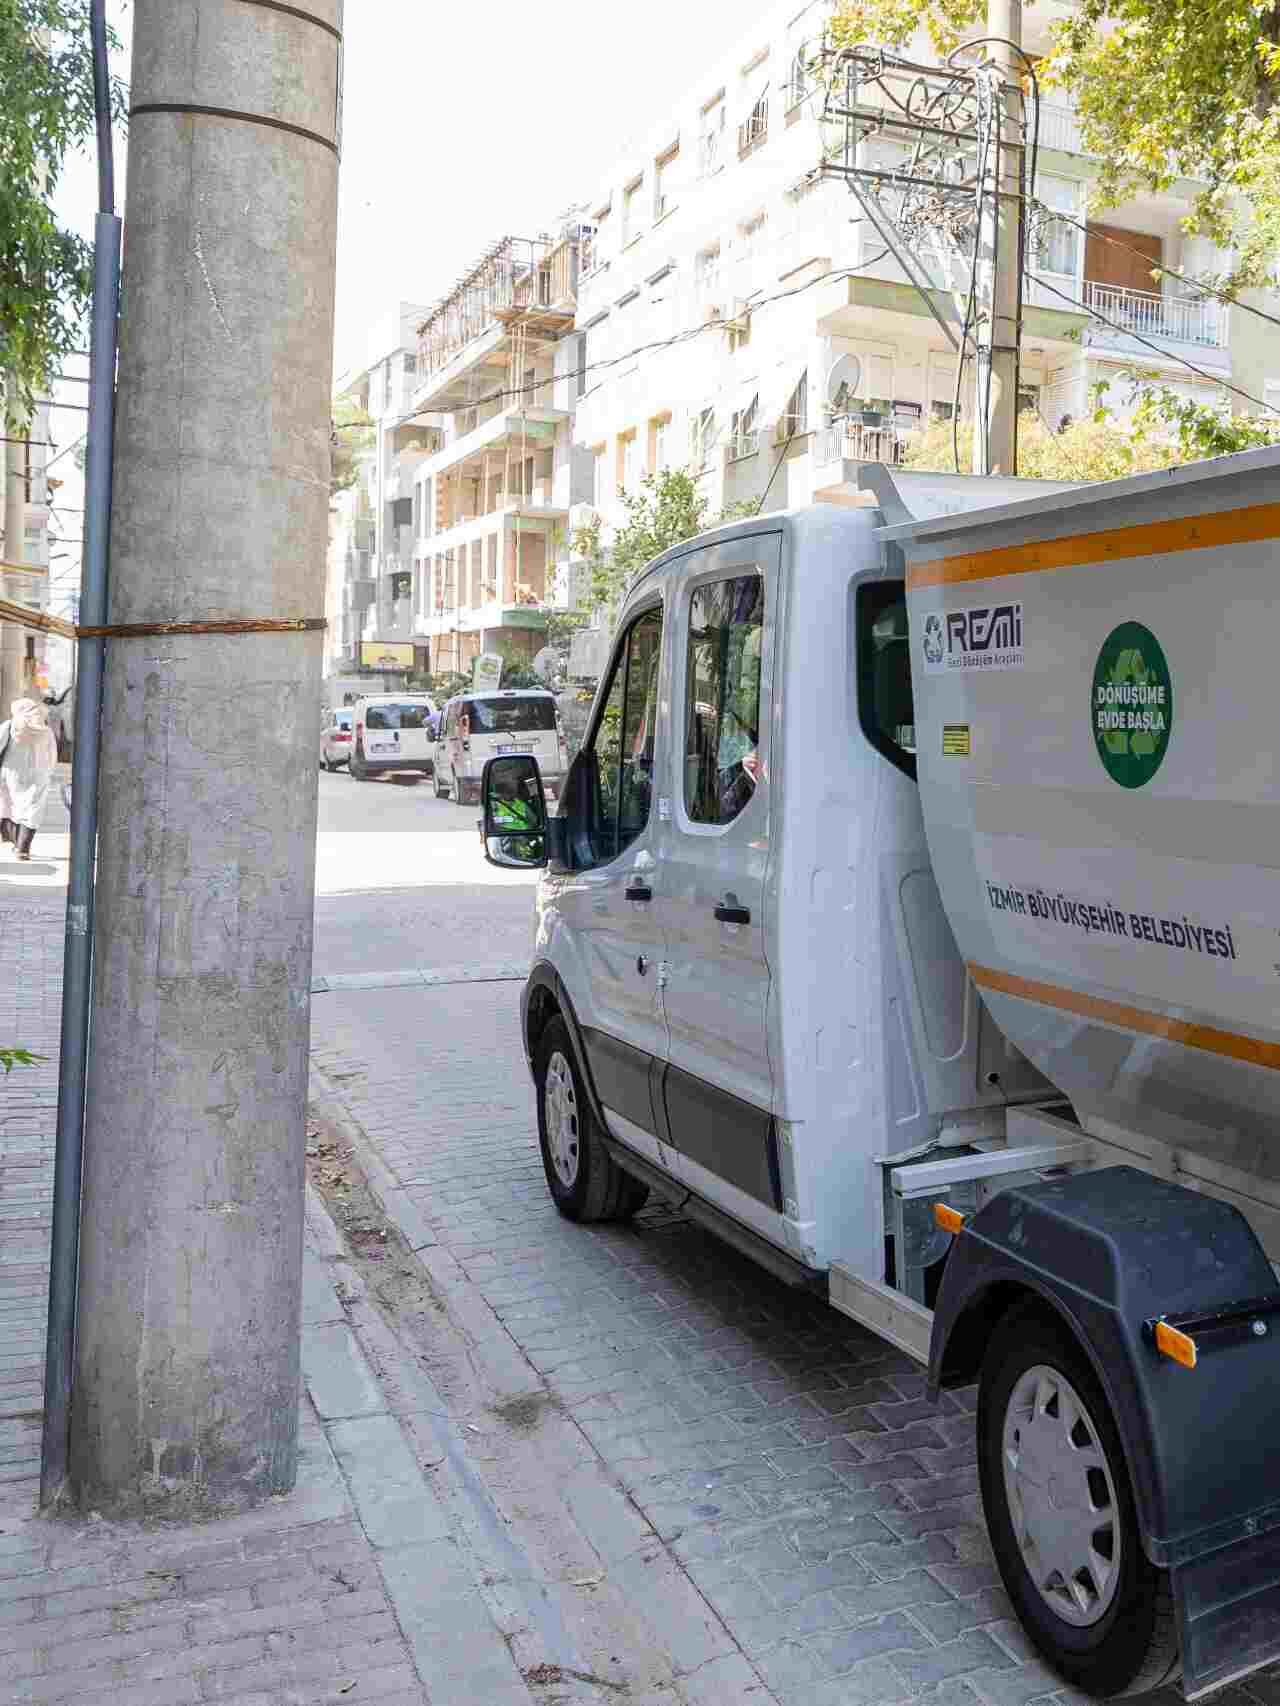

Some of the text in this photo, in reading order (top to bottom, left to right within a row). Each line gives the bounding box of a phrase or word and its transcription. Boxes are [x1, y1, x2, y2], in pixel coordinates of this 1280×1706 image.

[1096, 681, 1165, 708] DÖNÜŞÜME
[1097, 710, 1166, 733] EVDE BAŞLA
[985, 880, 1236, 959] İZMİR BÜYÜKŞEHİR BELEDİYESİ
